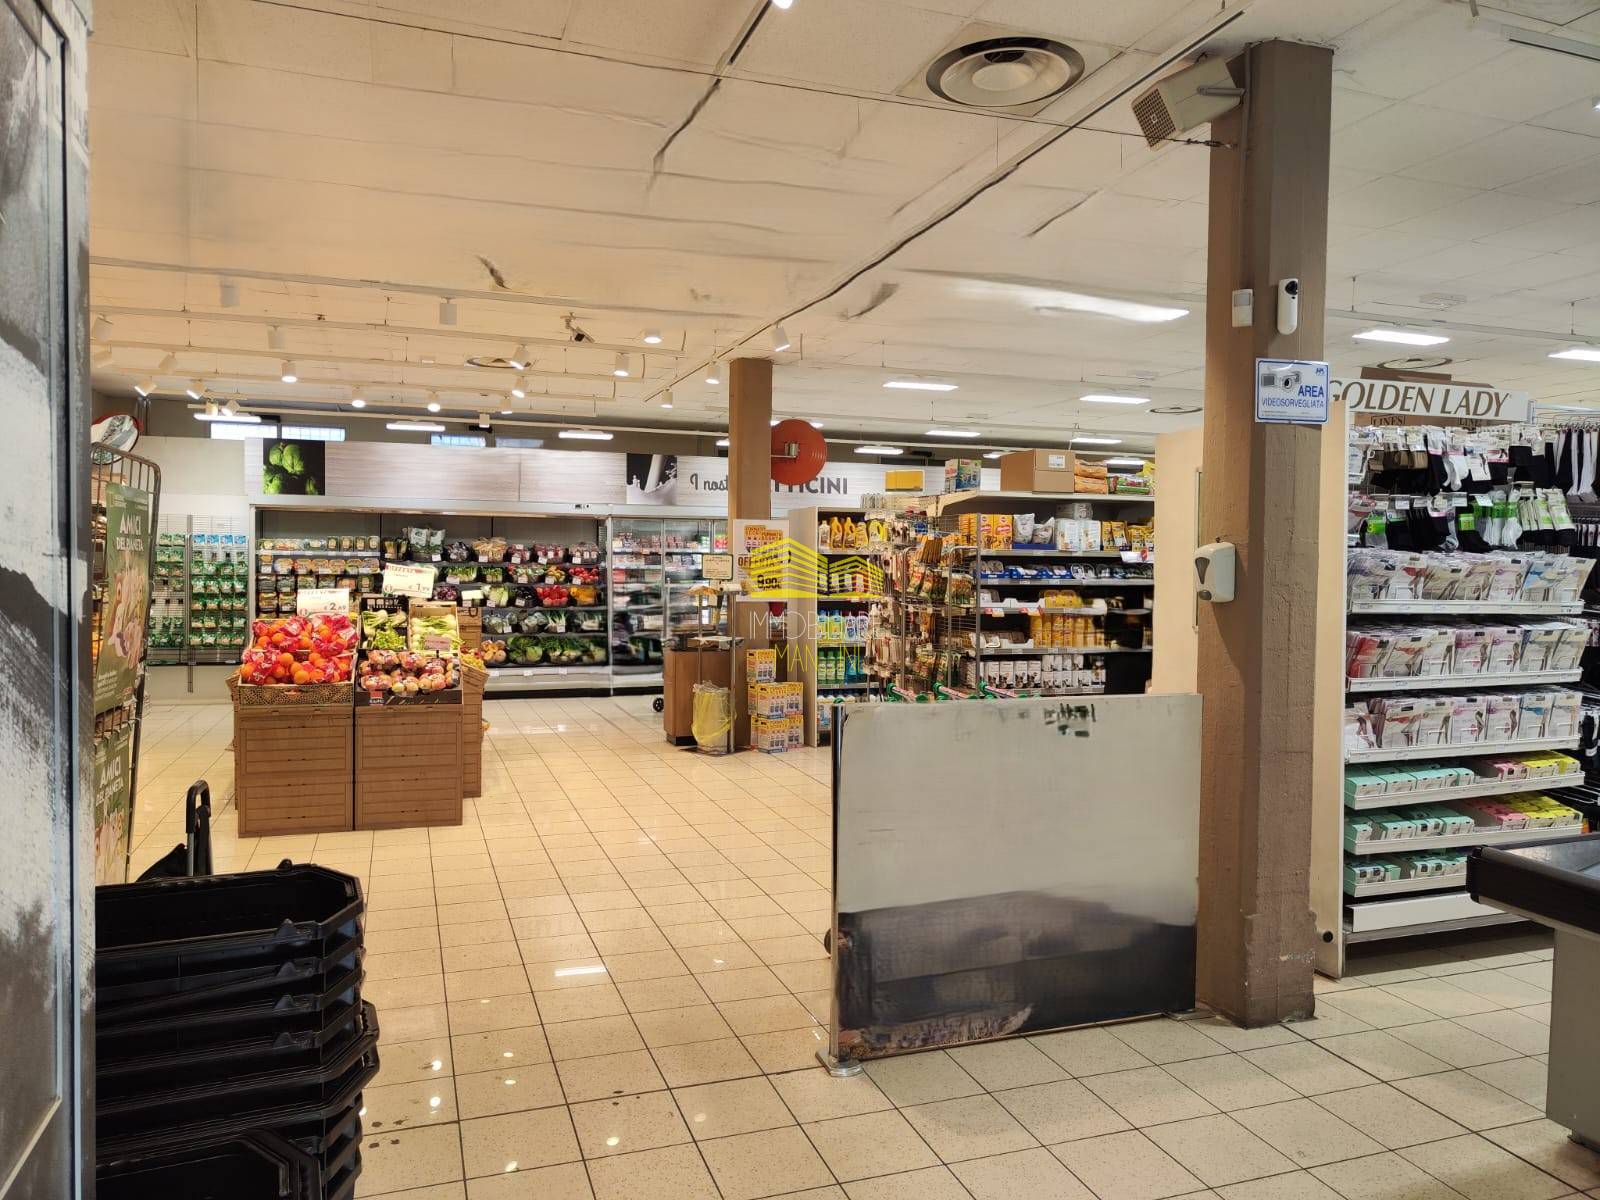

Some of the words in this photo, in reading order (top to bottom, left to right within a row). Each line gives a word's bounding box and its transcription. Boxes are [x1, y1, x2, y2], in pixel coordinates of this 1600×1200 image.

[1298, 385, 1324, 397] AREA
[1262, 396, 1324, 408] VIDEOSORVEGLIATA
[1440, 388, 1510, 417] LADY
[100, 755, 121, 789] AMICI
